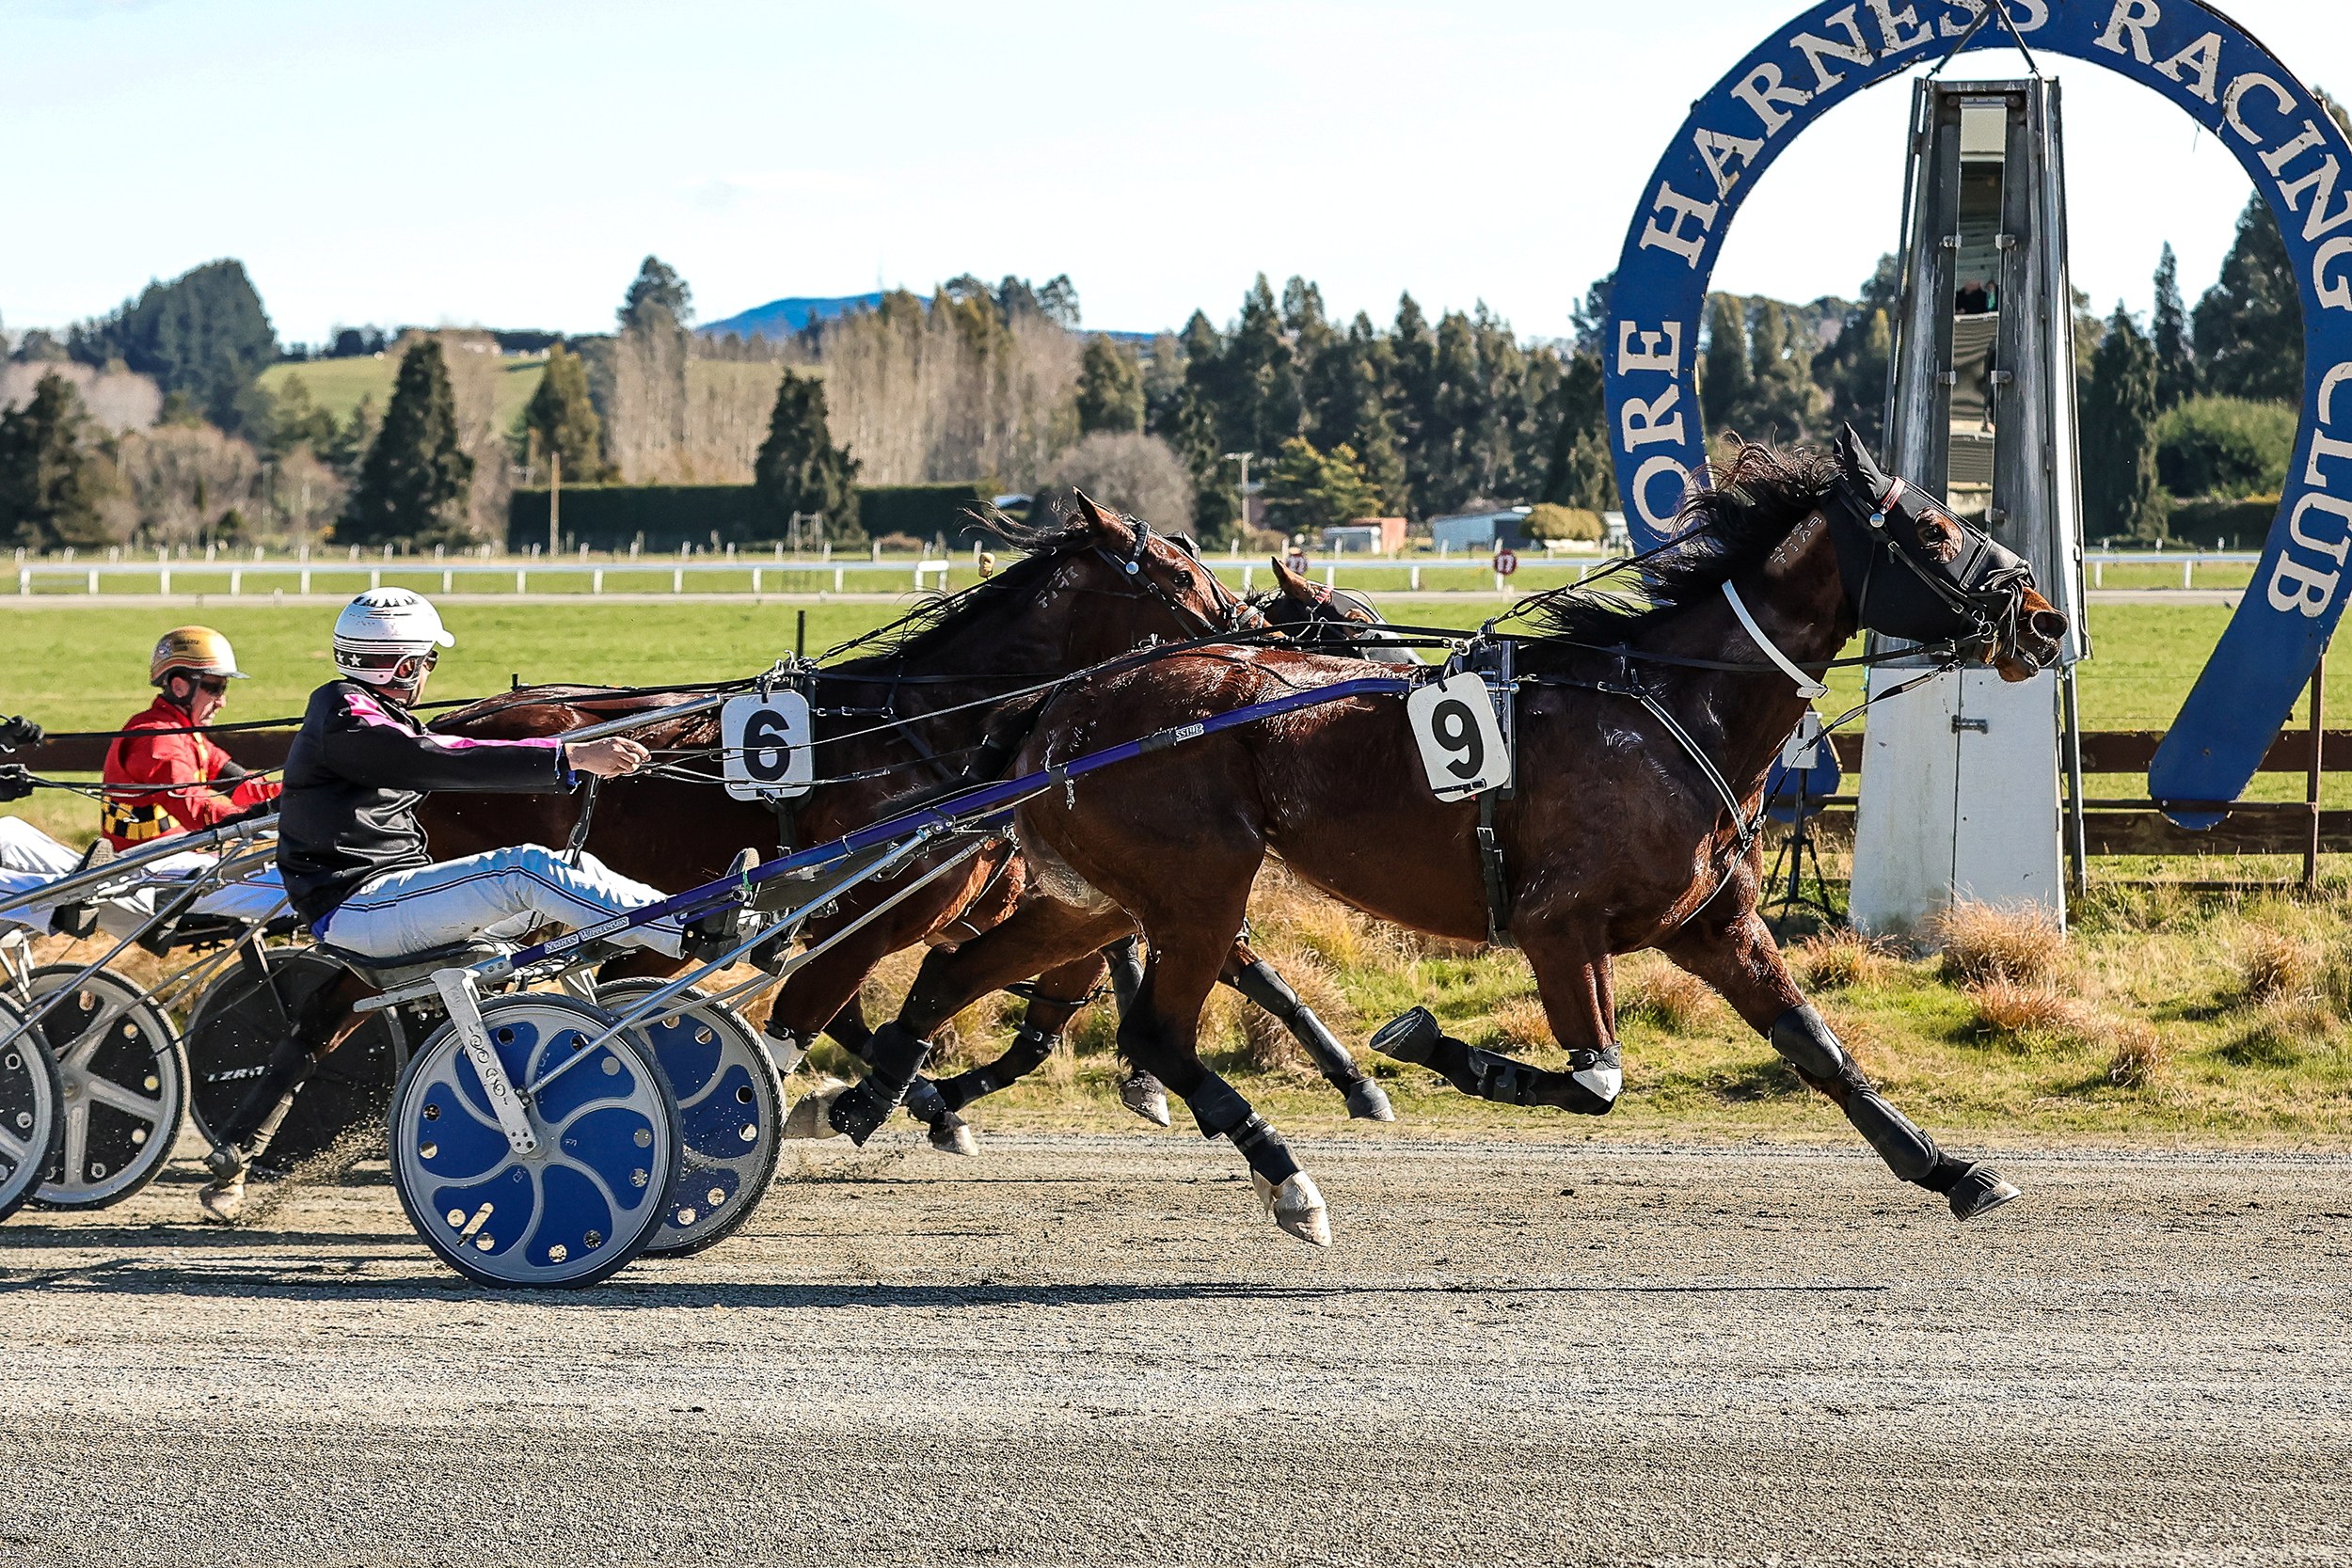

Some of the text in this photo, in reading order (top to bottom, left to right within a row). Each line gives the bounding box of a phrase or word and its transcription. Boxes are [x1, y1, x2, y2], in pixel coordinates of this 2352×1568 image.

[1617, 321, 1700, 550] ORE
[2092, 0, 2352, 311] RACING
[2267, 361, 2352, 617] CLUB
[743, 709, 790, 782] 6
[1432, 699, 1484, 779] 9
